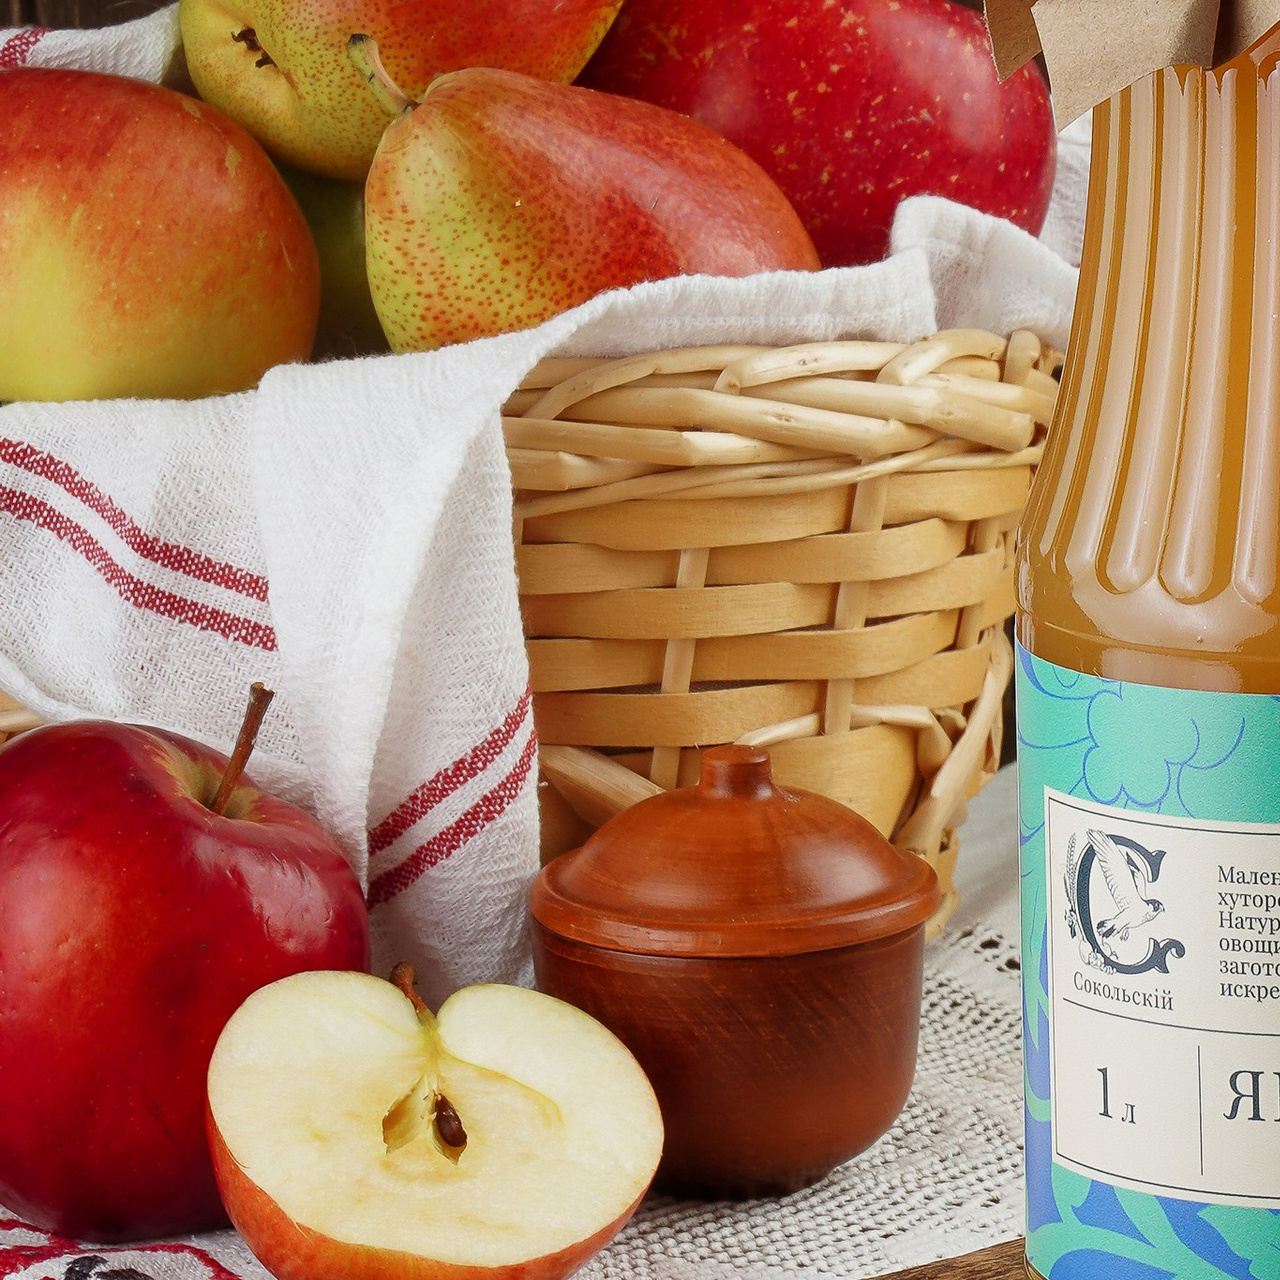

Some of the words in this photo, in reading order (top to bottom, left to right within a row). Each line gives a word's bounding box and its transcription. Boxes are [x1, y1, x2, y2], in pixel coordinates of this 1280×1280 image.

[1073, 970, 1174, 1011] Сокольскій
[1096, 1066, 1113, 1119] 1
[1121, 1102, 1137, 1125] л
